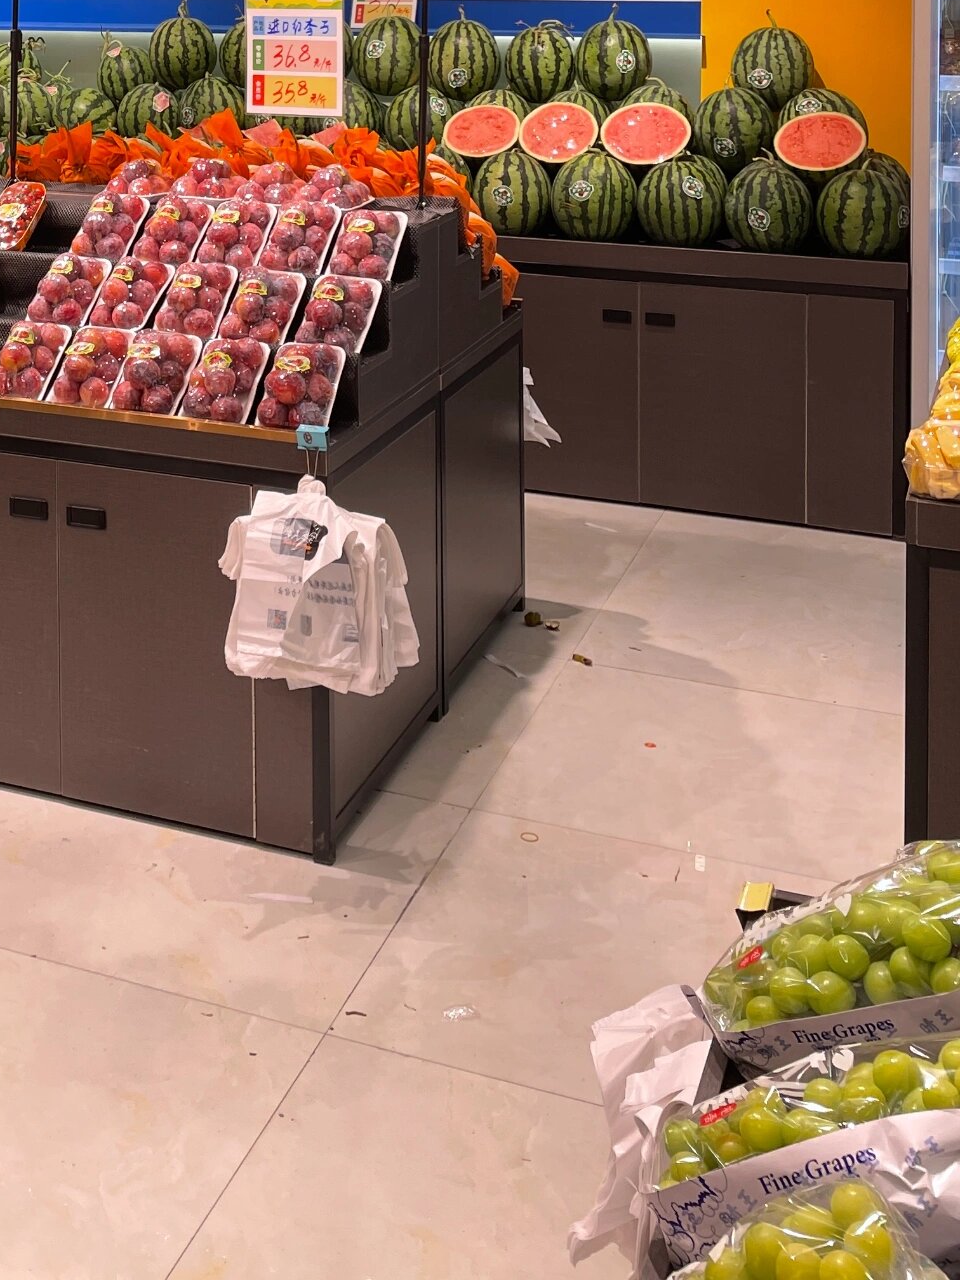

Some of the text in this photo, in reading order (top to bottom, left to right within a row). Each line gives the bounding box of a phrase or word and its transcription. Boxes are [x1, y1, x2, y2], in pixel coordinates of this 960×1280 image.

[792, 1028, 830, 1046] Fine
[833, 1019, 895, 1040] Grapes
[757, 1146, 877, 1196] Fine Grapes
